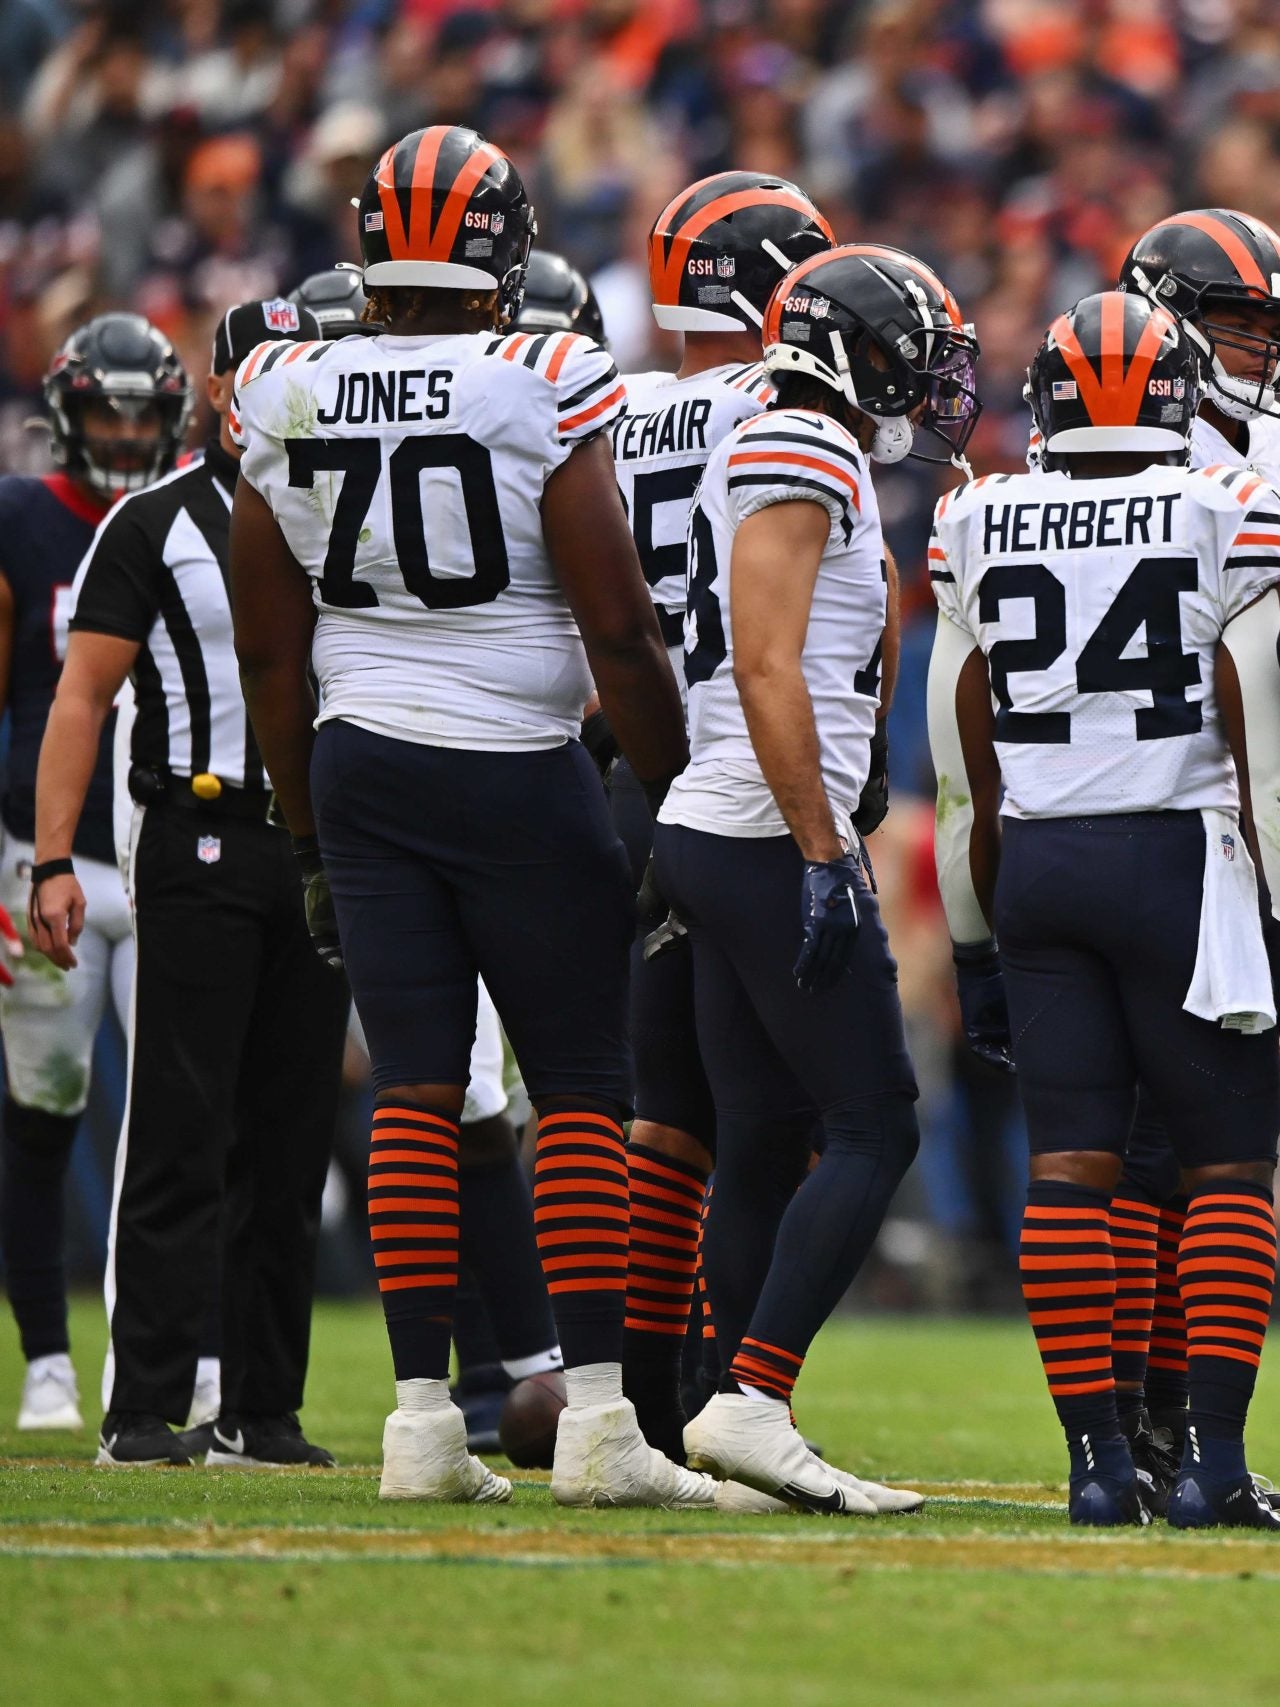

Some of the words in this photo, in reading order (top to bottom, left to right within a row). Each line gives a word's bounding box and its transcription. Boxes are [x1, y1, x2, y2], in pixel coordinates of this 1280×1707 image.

[465, 211, 489, 229] GSH
[688, 259, 713, 275] GSH
[785, 296, 809, 313] GSH
[317, 370, 453, 424] JONES
[1149, 379, 1171, 396] GSH
[283, 432, 511, 610] 70
[984, 493, 1181, 554] HERBERT
[978, 558, 1203, 744] 24
